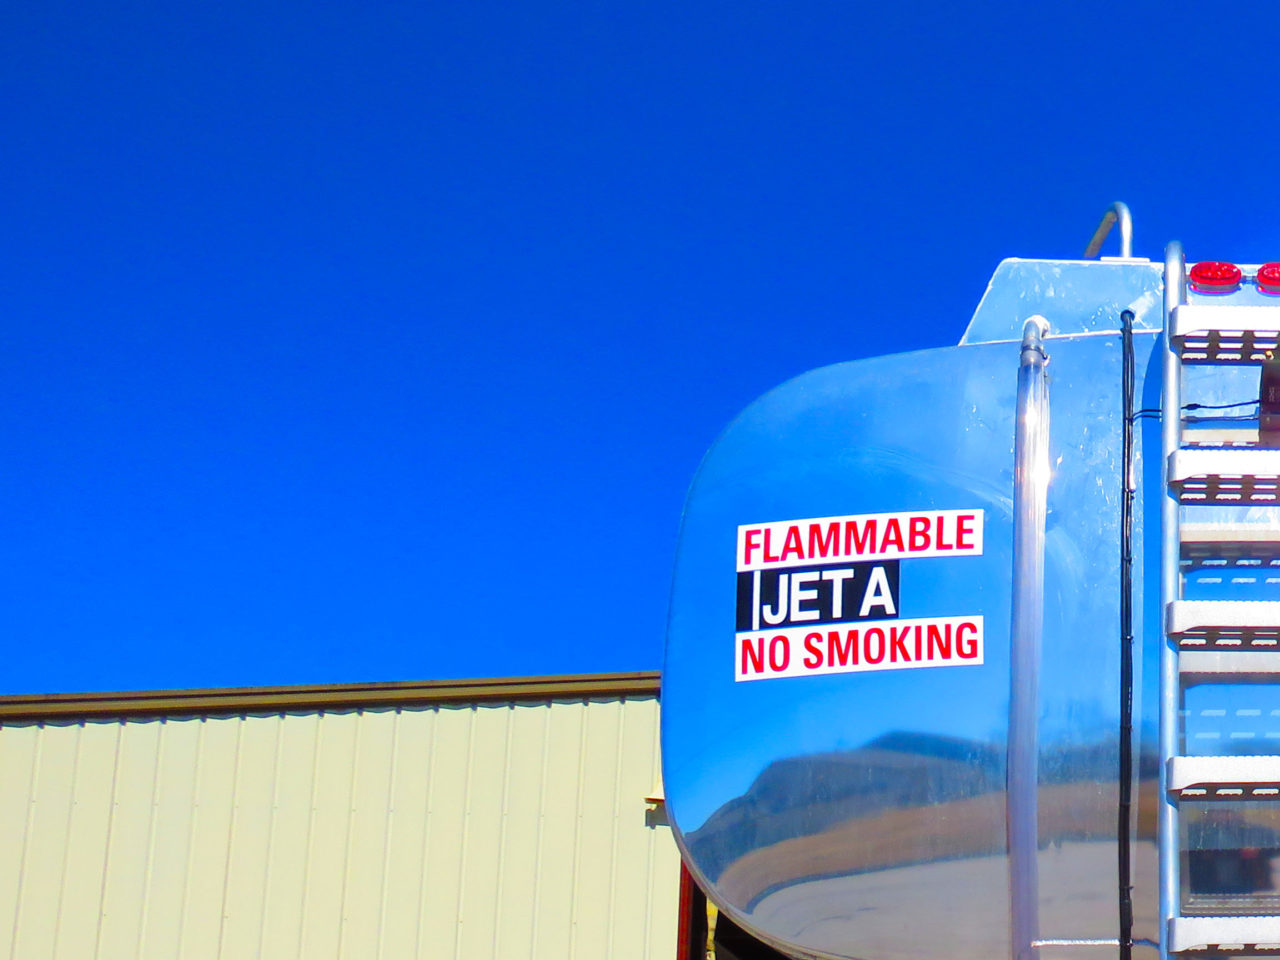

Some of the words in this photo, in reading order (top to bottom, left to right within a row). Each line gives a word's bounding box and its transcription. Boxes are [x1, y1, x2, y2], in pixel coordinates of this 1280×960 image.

[744, 514, 975, 565] FLAMMABLE
[859, 566, 896, 617] A
[741, 634, 790, 675] NO
[803, 622, 978, 670] SMOKING
